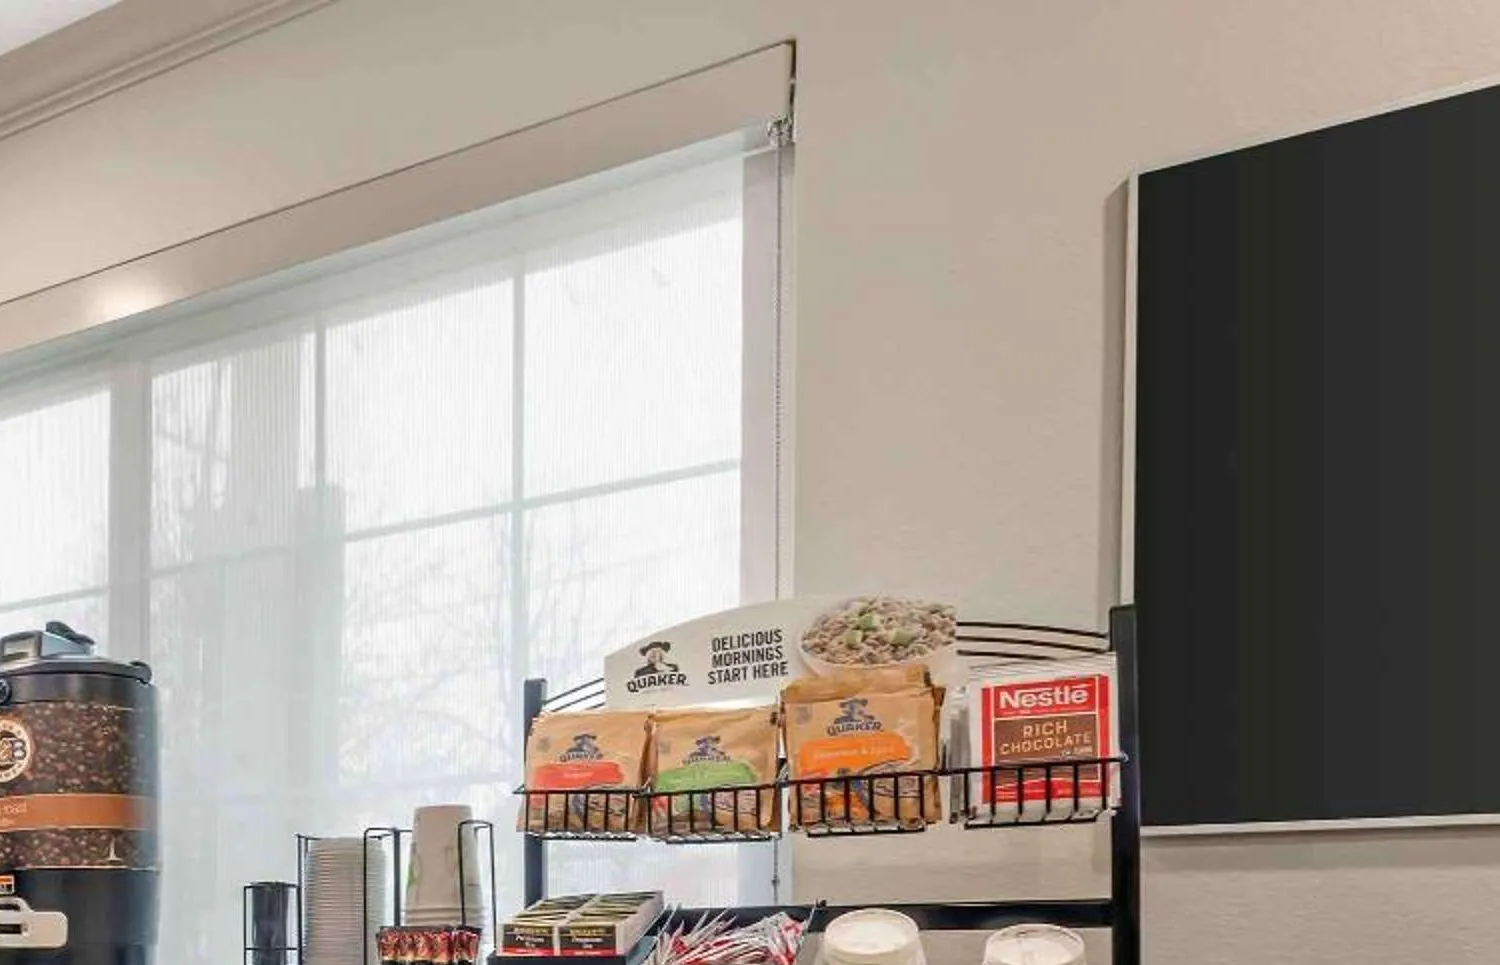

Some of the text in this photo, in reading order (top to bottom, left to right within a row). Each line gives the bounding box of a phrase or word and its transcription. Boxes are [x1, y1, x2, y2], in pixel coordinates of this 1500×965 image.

[711, 629, 783, 652] DELICIOUS
[711, 646, 783, 669] MORNINGS
[626, 672, 688, 693] QUAKER
[707, 661, 788, 685] START HERE
[827, 720, 883, 736] QUAKER
[1023, 720, 1068, 738] RICH
[1000, 731, 1093, 755] CHOCOLATE
